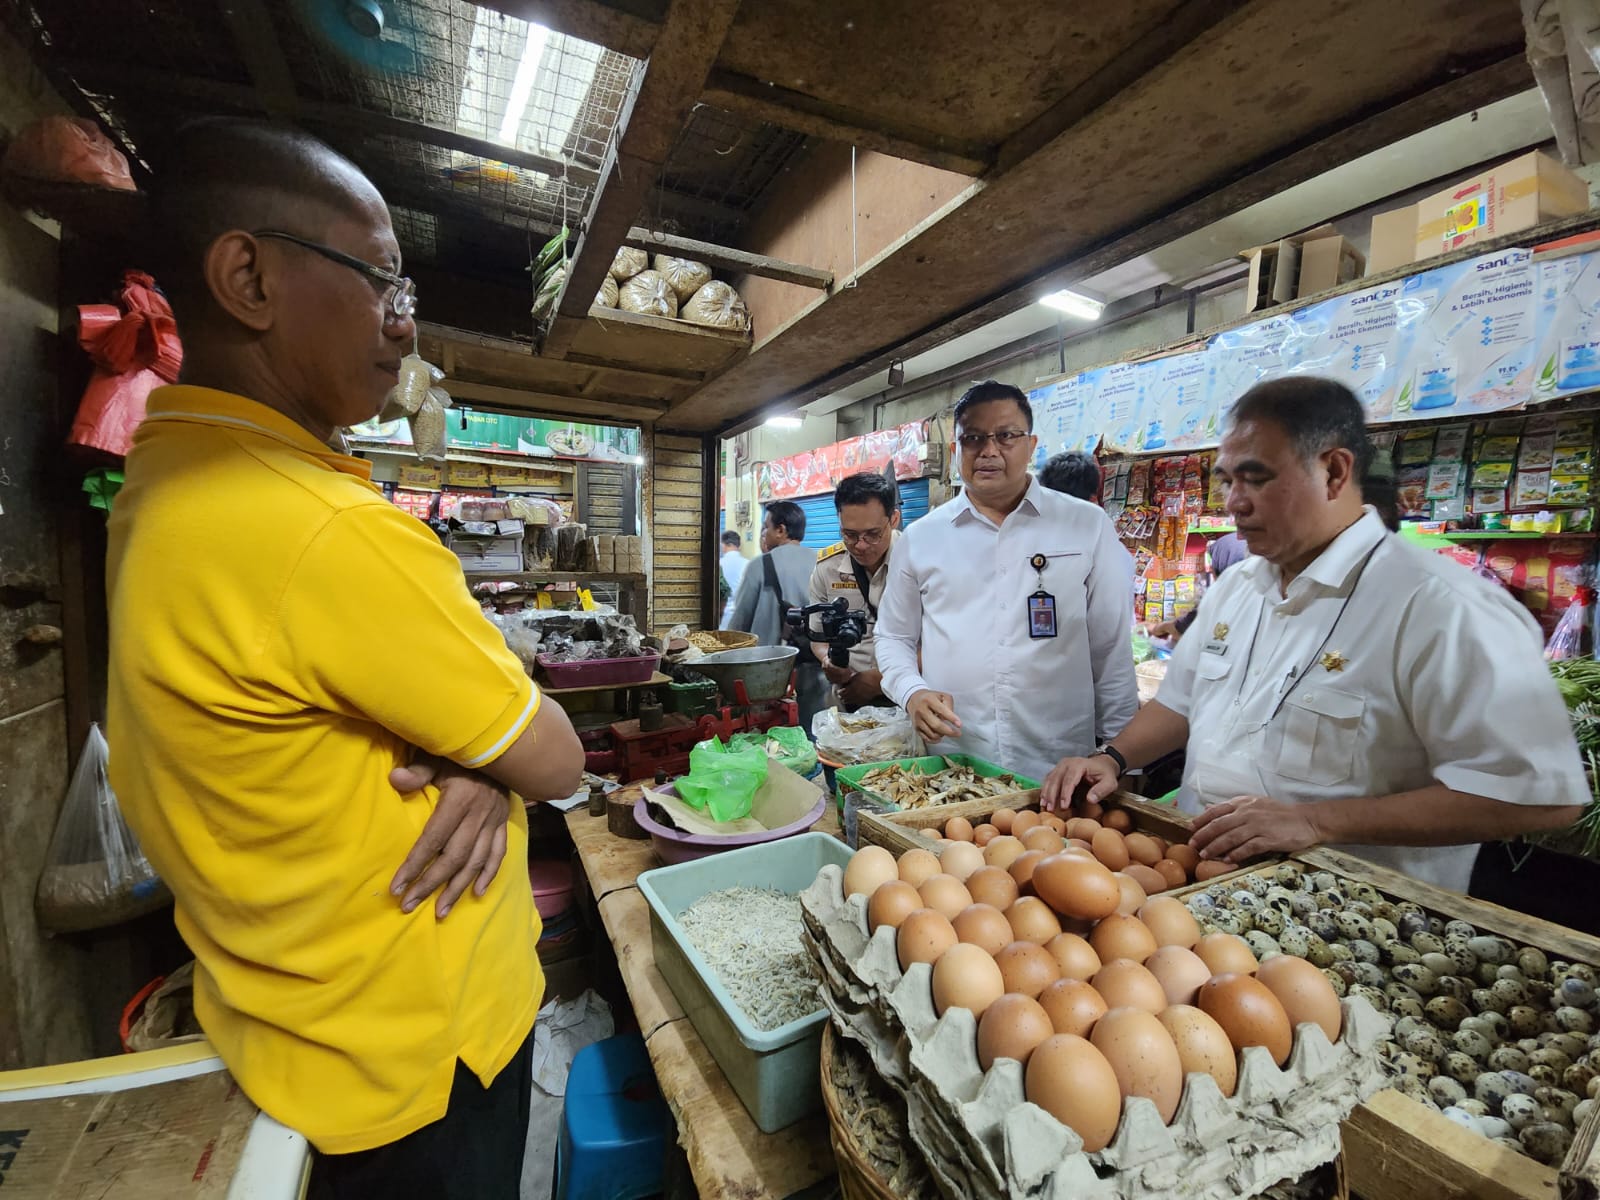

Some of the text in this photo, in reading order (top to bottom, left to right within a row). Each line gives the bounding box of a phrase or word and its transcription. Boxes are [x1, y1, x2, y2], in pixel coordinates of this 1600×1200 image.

[1461, 299, 1485, 310] Lebih
[1487, 288, 1532, 303] Ekonomis
[1462, 280, 1533, 301] Bersih, Higienis
